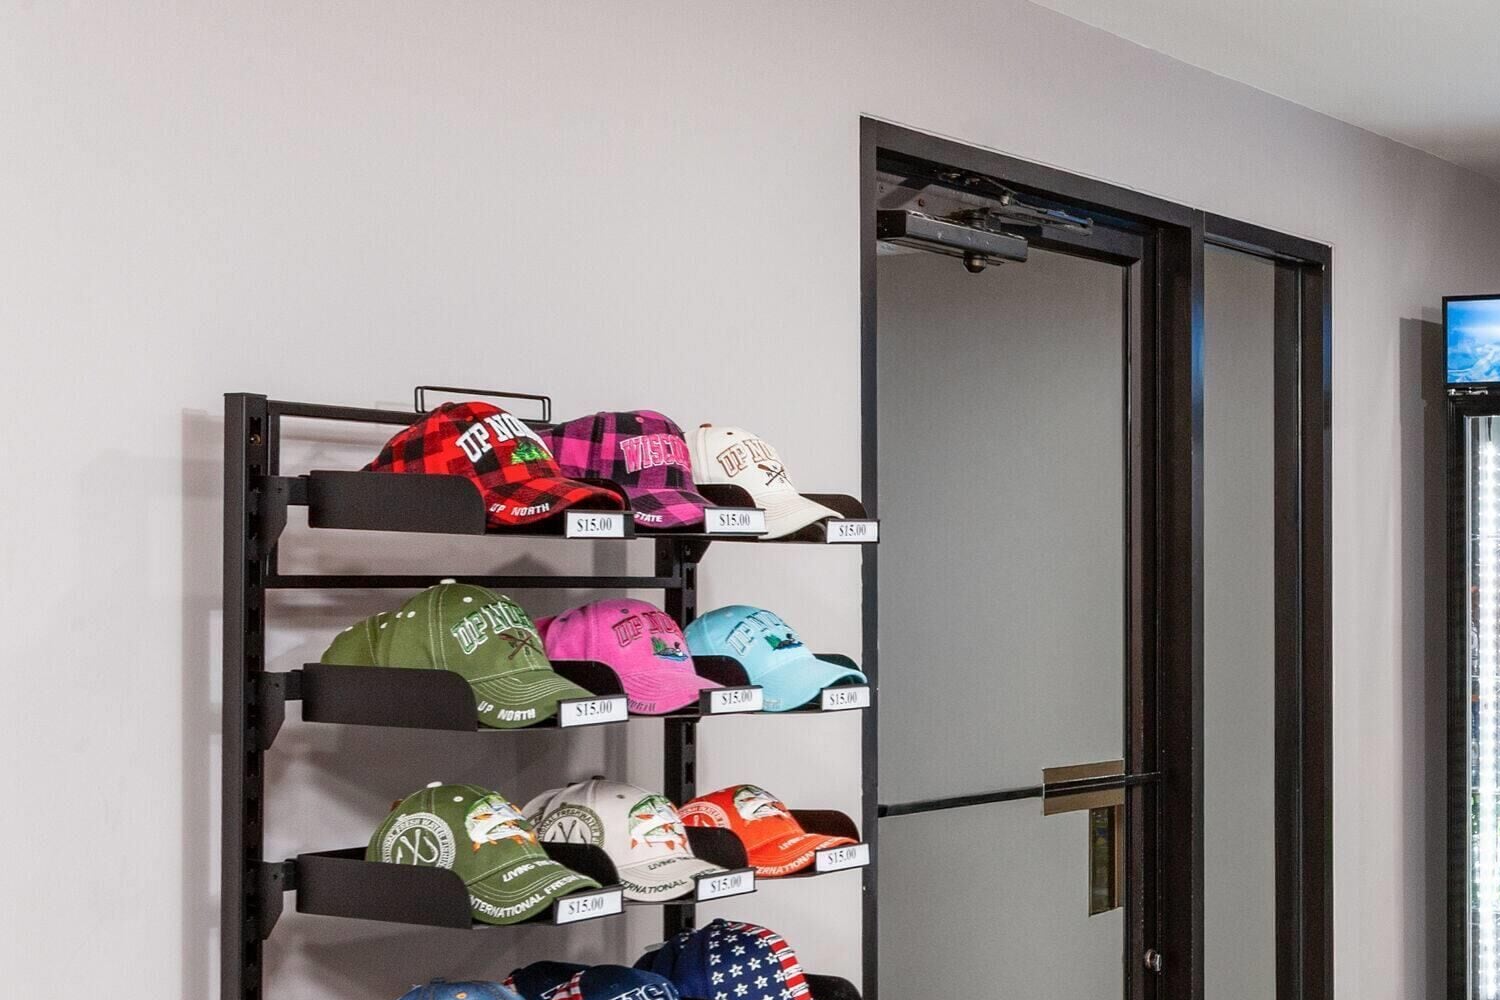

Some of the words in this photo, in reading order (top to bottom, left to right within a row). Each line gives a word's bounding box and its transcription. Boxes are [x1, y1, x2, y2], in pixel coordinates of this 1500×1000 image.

[456, 423, 492, 463] UP
[716, 443, 749, 477] UP
[489, 503, 507, 513] UP
[511, 502, 550, 517] NORTH
[576, 518, 612, 532] $15.00
[719, 512, 750, 527] $15.00
[838, 524, 866, 537] $15.00
[450, 610, 488, 655] UP
[612, 615, 644, 648] UP
[628, 698, 657, 712] ORTH
[721, 690, 752, 706] $15.00
[829, 691, 857, 706] $15.00
[477, 701, 494, 714] UP
[497, 708, 536, 722] NORTH
[575, 700, 613, 717] $15.00
[828, 848, 857, 864] $15.00
[502, 863, 535, 883] LIVING
[711, 875, 741, 893] $15.00
[470, 893, 545, 918] NTERNATIONAL
[567, 897, 604, 915] $15.00
